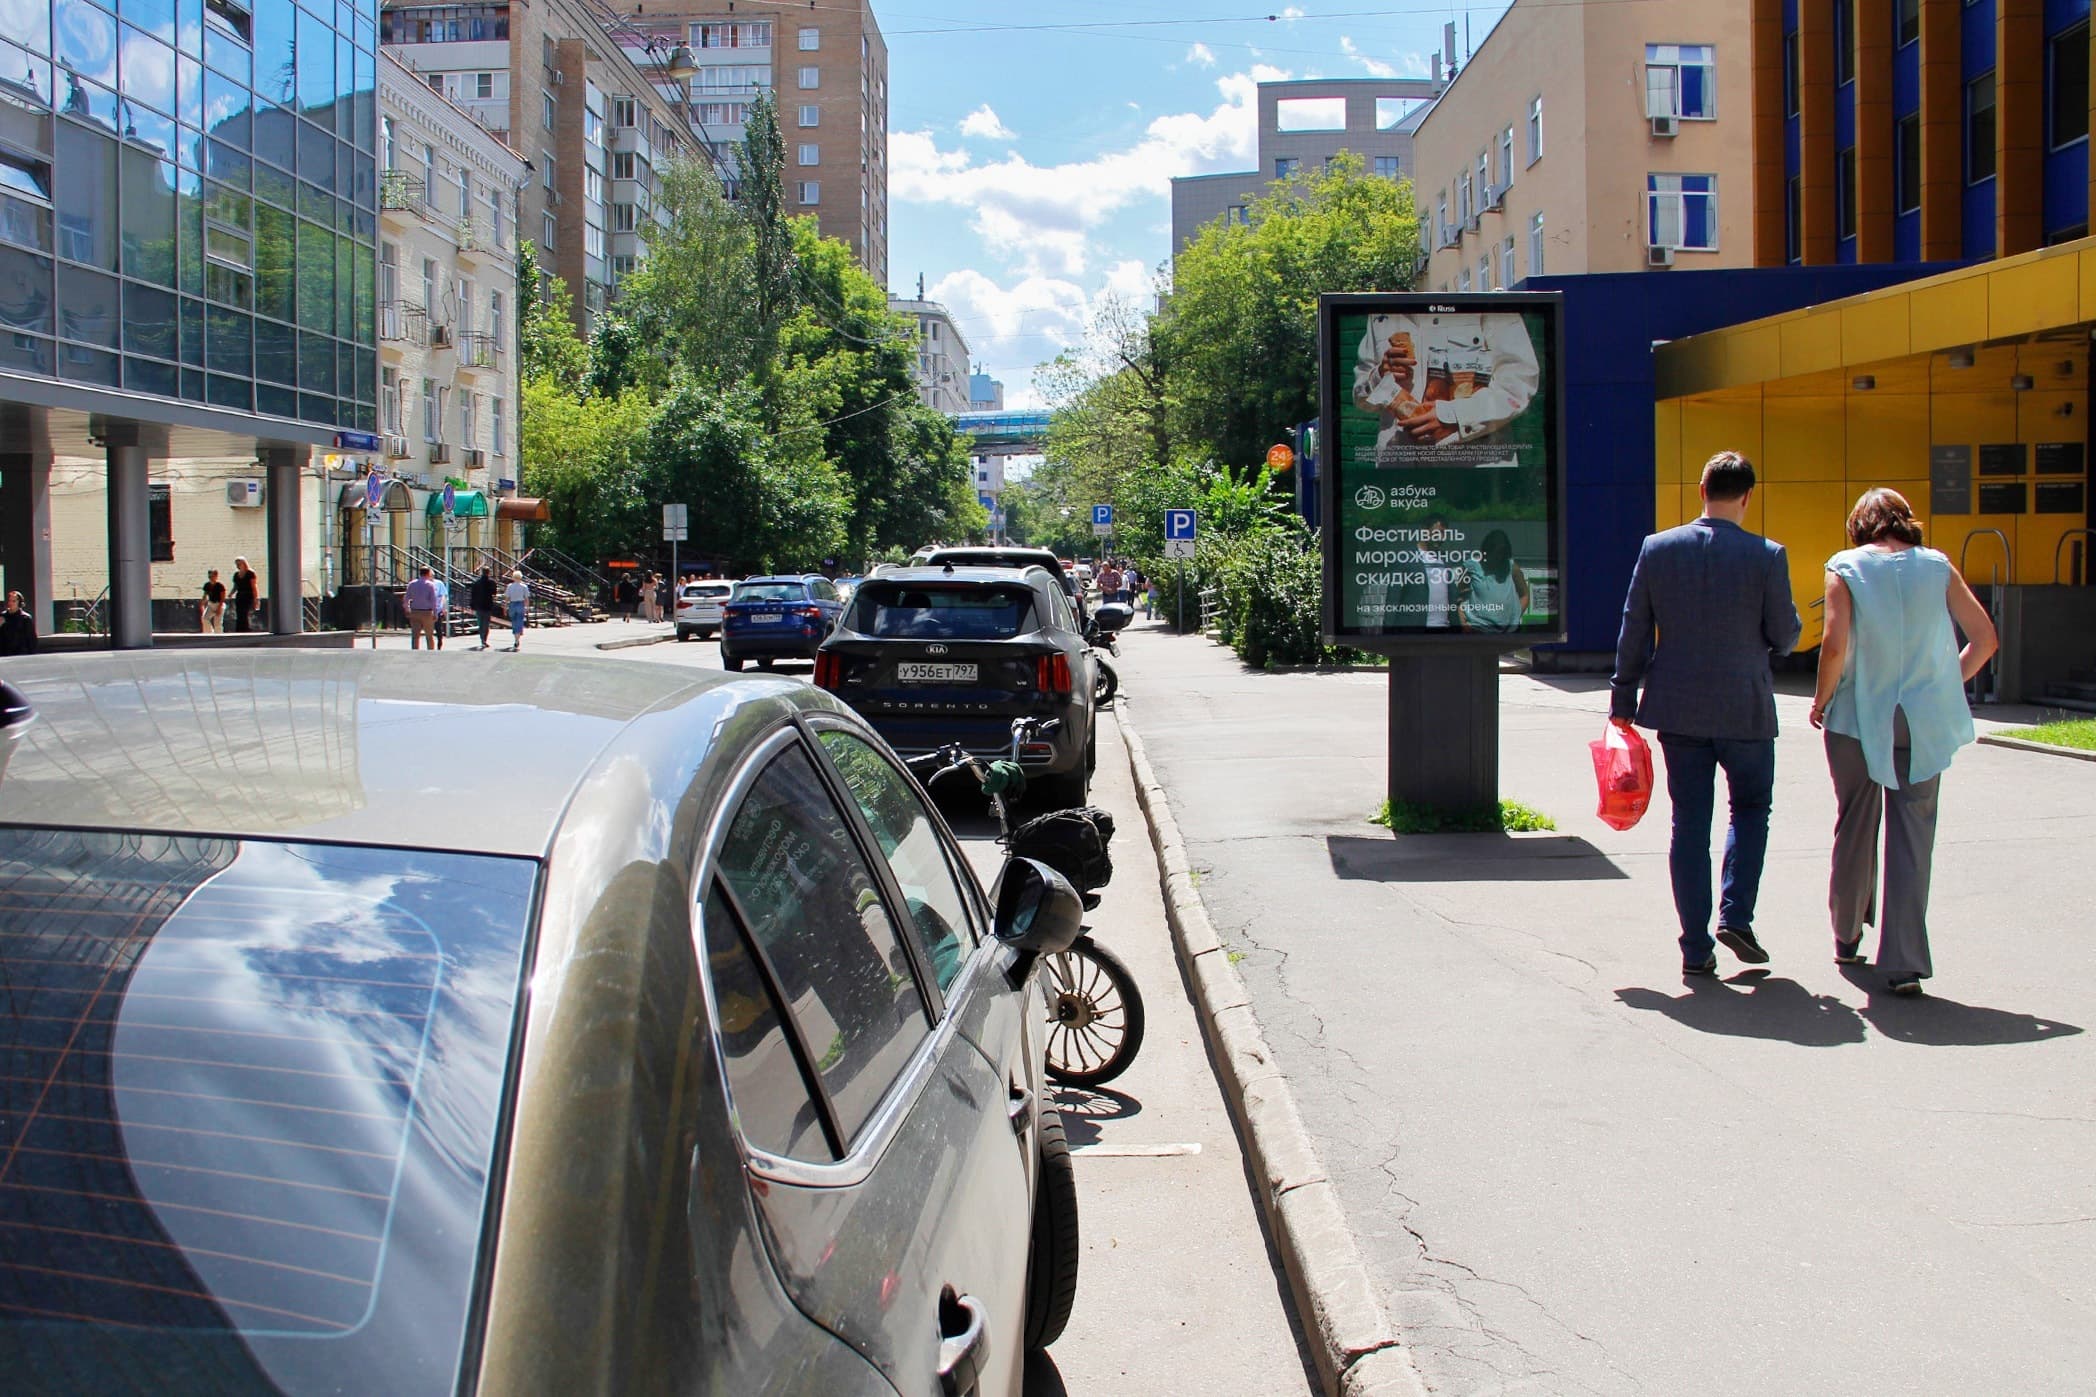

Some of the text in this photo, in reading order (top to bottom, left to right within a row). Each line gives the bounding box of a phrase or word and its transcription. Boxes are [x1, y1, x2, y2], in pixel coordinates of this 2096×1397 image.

[1390, 484, 1436, 498] азбука
[1390, 498, 1428, 510] вкуса
[1173, 513, 1190, 537] P
[1355, 525, 1465, 543] Фестиваль
[1355, 549, 1487, 567] мороженого:
[1355, 567, 1471, 587] скидка 30%
[1356, 601, 1504, 614] на эксклюзивные бренды
